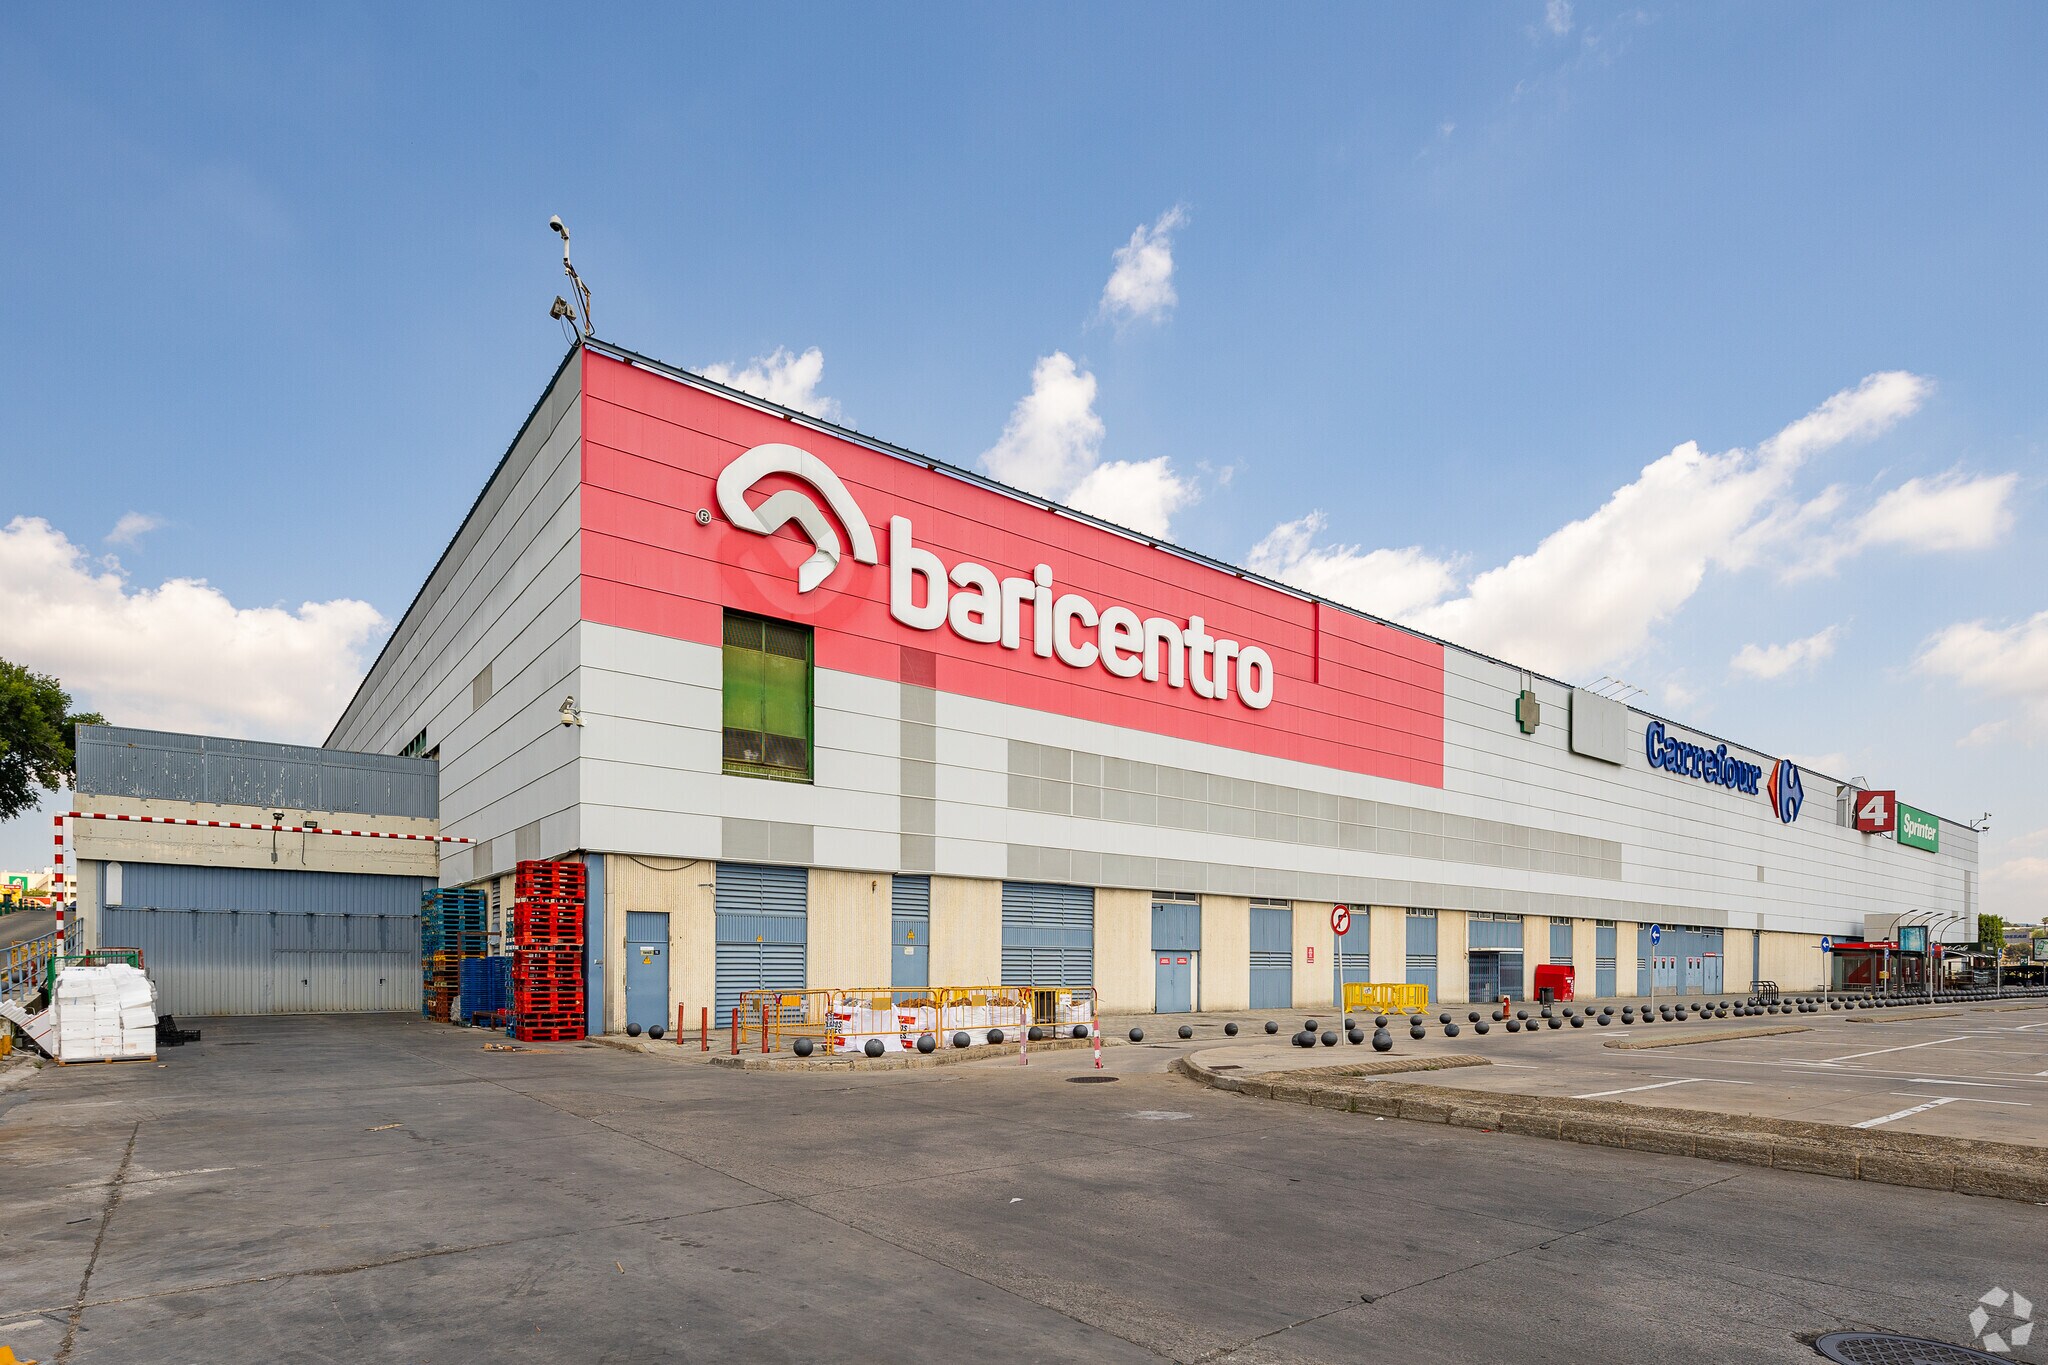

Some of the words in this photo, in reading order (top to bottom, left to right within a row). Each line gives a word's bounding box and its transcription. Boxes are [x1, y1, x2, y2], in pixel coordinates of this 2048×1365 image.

[890, 515, 1273, 709] baricentro
[1646, 721, 1762, 795] Carrefour
[1859, 796, 1888, 826] 4
[1904, 813, 1936, 841] Sprinter
